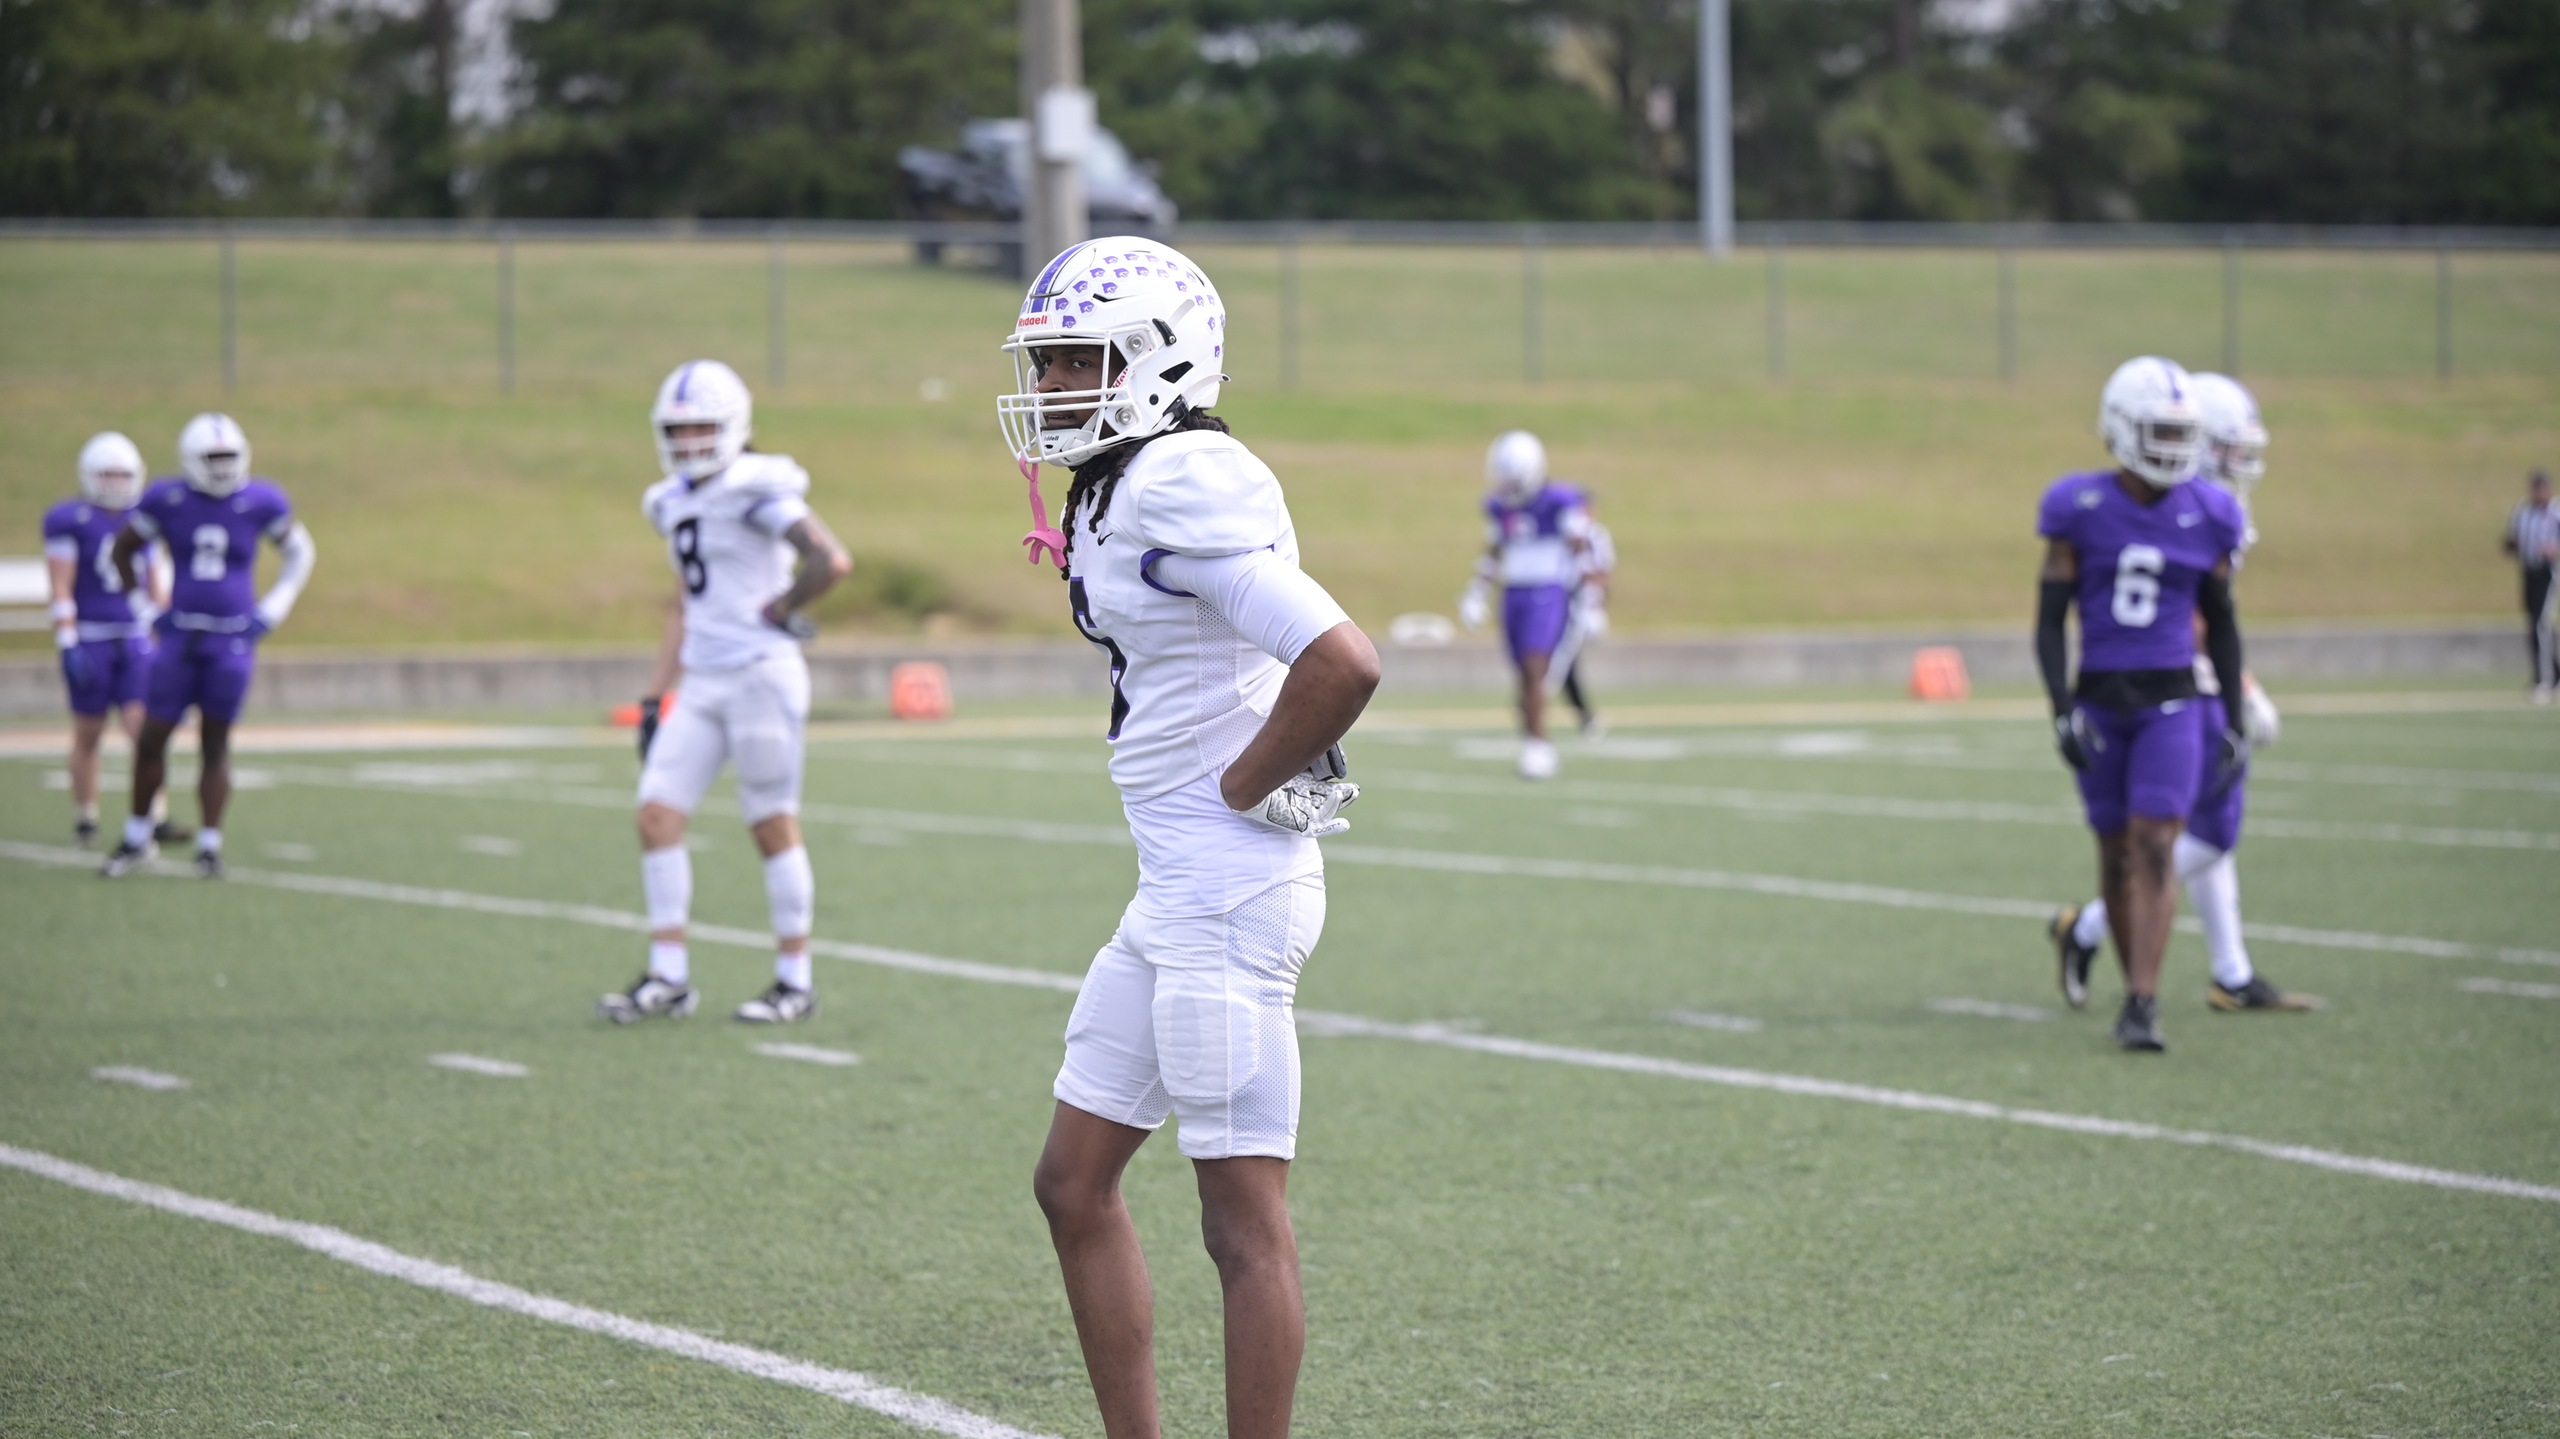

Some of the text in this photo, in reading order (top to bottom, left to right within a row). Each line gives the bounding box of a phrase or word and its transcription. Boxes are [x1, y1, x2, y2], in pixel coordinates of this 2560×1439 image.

[190, 523, 229, 581] 2
[673, 516, 707, 596] 8
[2111, 542, 2165, 628] 6
